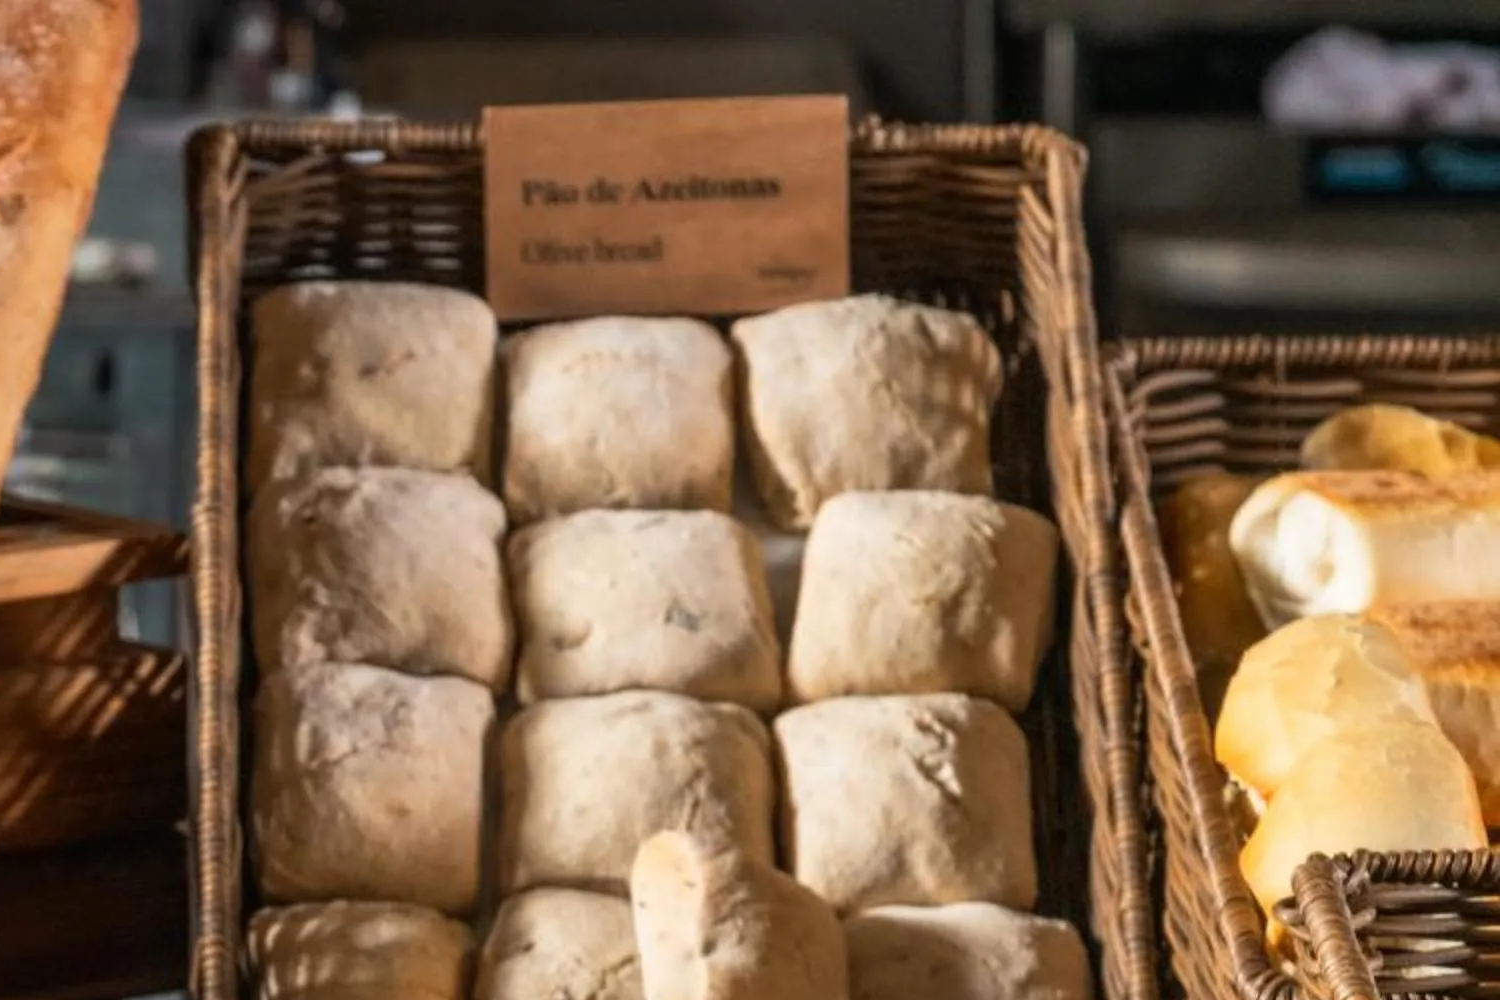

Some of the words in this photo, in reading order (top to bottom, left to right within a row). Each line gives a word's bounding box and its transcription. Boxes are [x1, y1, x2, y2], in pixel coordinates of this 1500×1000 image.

[587, 175, 624, 204] de
[632, 174, 782, 204] Azeitonas
[520, 237, 589, 265] Olive
[593, 235, 664, 262] bread
